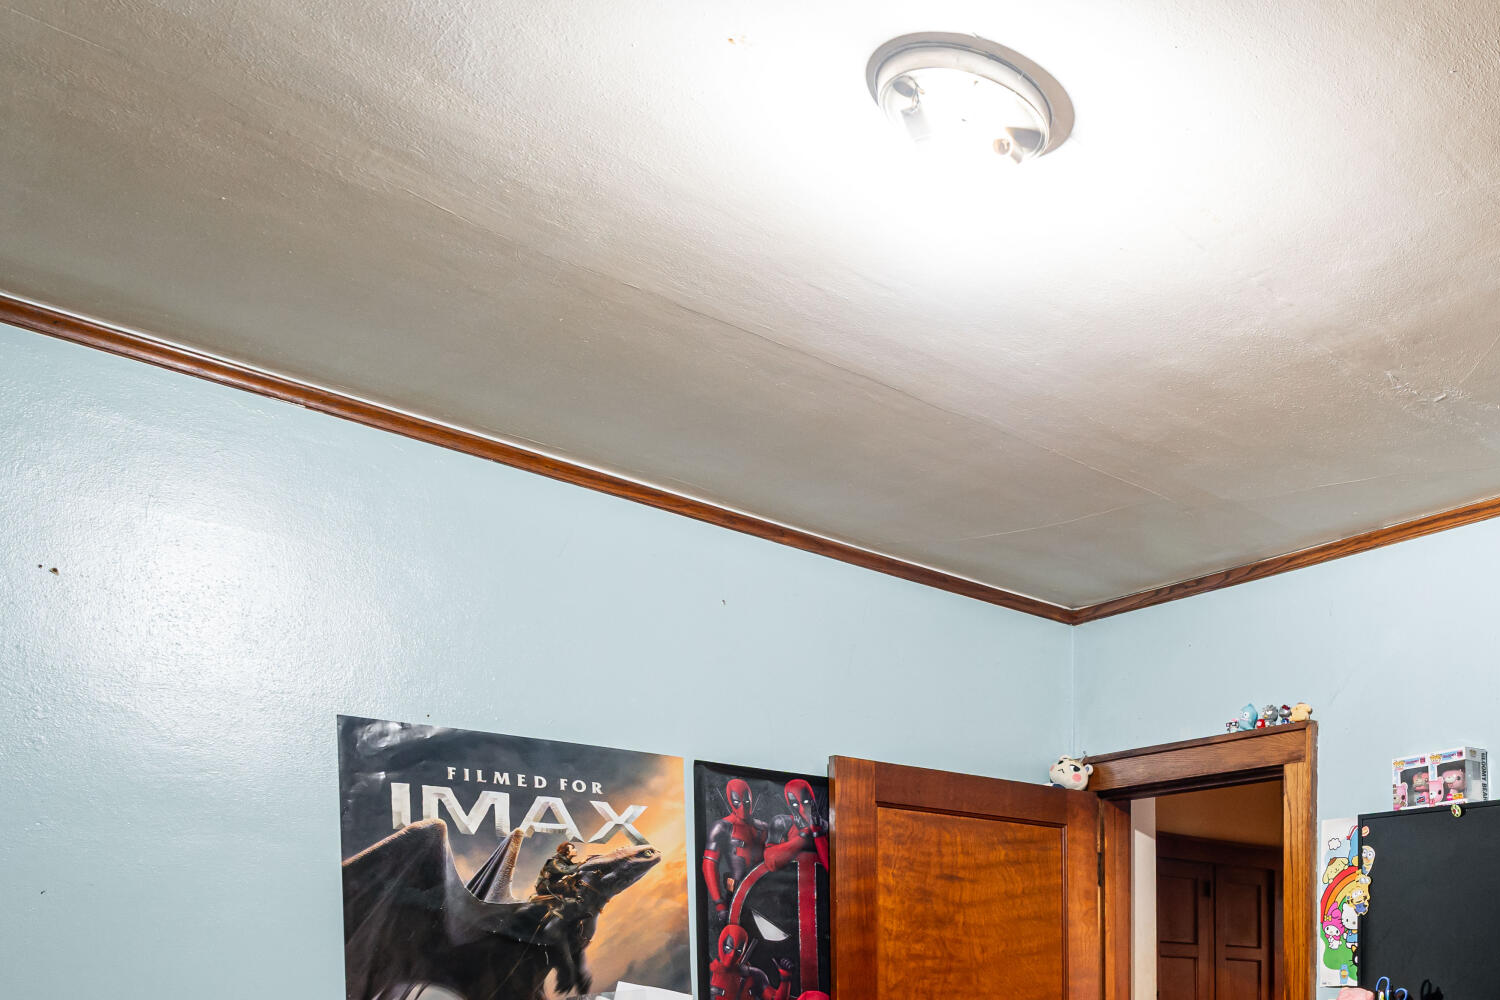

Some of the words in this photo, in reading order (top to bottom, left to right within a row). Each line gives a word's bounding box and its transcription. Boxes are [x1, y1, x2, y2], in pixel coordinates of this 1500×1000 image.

[447, 766, 547, 789] FILMED
[560, 778, 603, 795] FOR
[390, 782, 649, 846] IMAX
